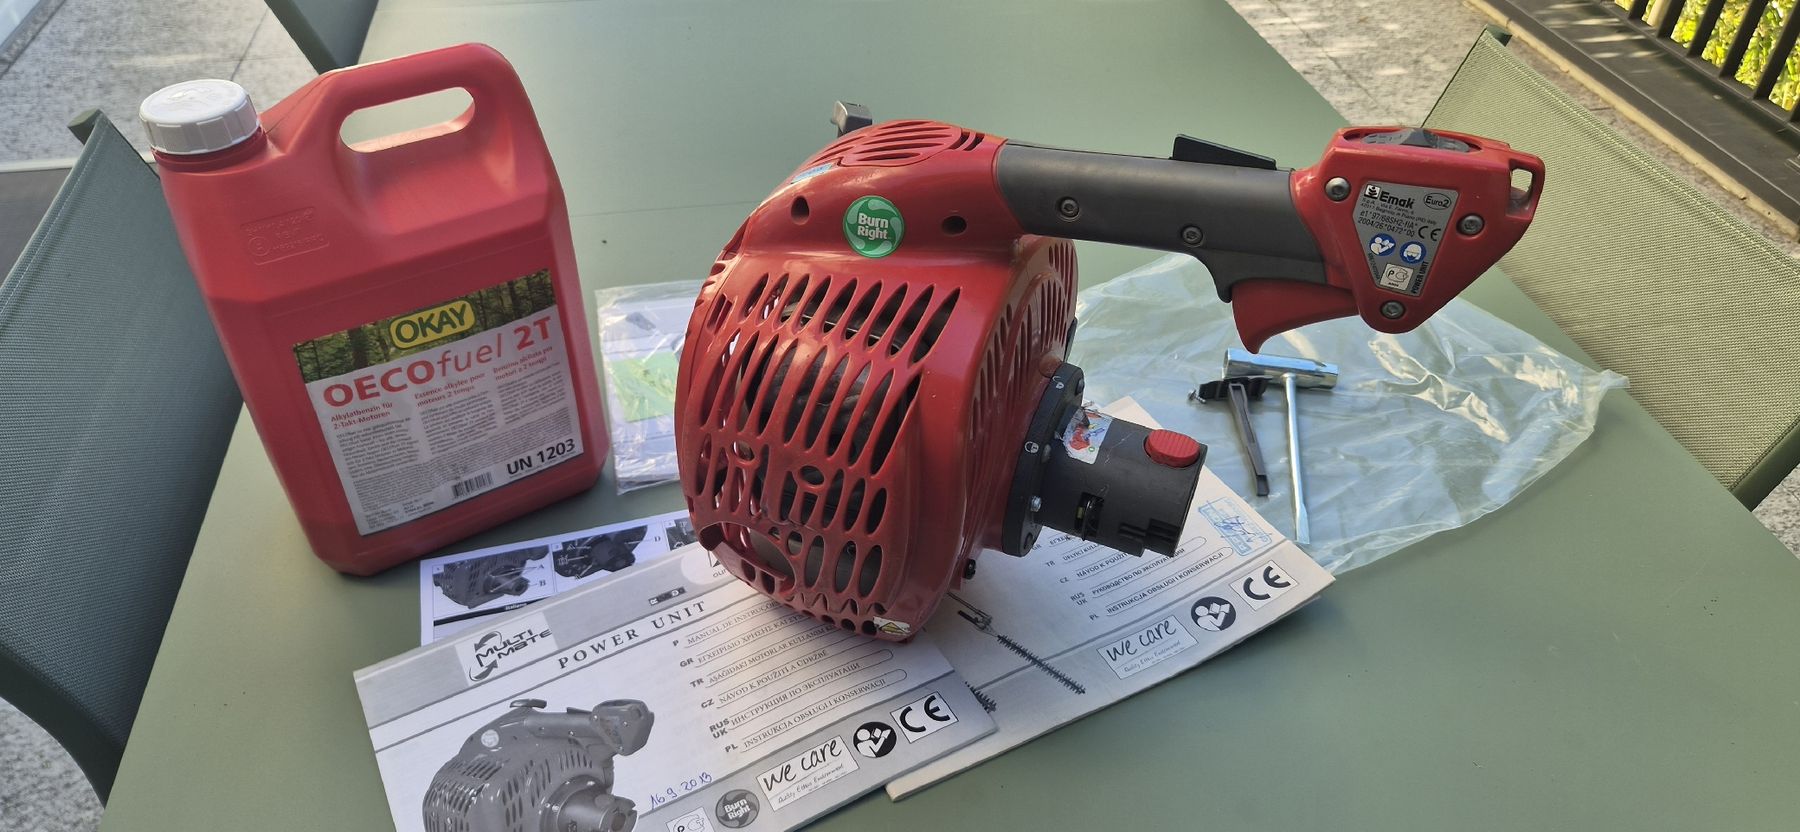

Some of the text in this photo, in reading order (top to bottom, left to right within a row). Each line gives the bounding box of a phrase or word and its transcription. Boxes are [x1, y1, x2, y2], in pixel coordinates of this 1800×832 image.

[1379, 191, 1415, 210] Emak
[1425, 196, 1450, 208] Euro2
[858, 213, 888, 228] Burn
[858, 226, 888, 240] Right
[395, 304, 468, 344] OKAY
[323, 333, 502, 408] OECOfuel
[514, 316, 551, 351] 2T
[331, 406, 380, 422] Alkylatbenzin
[334, 412, 390, 430] 2-Takt-Motoren
[506, 456, 532, 476] UN
[536, 438, 576, 463] 1203
[1070, 592, 1086, 600] RUS
[1106, 592, 1147, 614] INSTRUKCJA
[1179, 552, 1224, 580] KONSERWACJI
[1243, 566, 1291, 600] CE
[558, 601, 705, 668] POWER UNIT
[687, 626, 722, 644] MANUAL
[722, 621, 734, 629] DE
[1106, 640, 1138, 662] we
[1139, 620, 1176, 647] care
[476, 629, 533, 667] MULTI
[680, 658, 694, 668] GR
[690, 678, 704, 688] TR
[748, 644, 788, 664] MOTORLAR
[701, 699, 714, 708] CZ
[719, 686, 748, 704] NÁVOD
[750, 682, 757, 691] K
[709, 718, 730, 733] RUS
[731, 694, 788, 726] ИНСТРУКЦИЯ
[725, 743, 738, 752] PL
[744, 720, 794, 748] INSTRUKCJA
[834, 678, 886, 704] KONSERWACJI
[899, 694, 950, 733] CE
[712, 728, 728, 739] UK
[762, 763, 796, 792] we
[800, 739, 842, 771] care
[724, 798, 748, 812] Burn
[727, 806, 752, 820] Right
